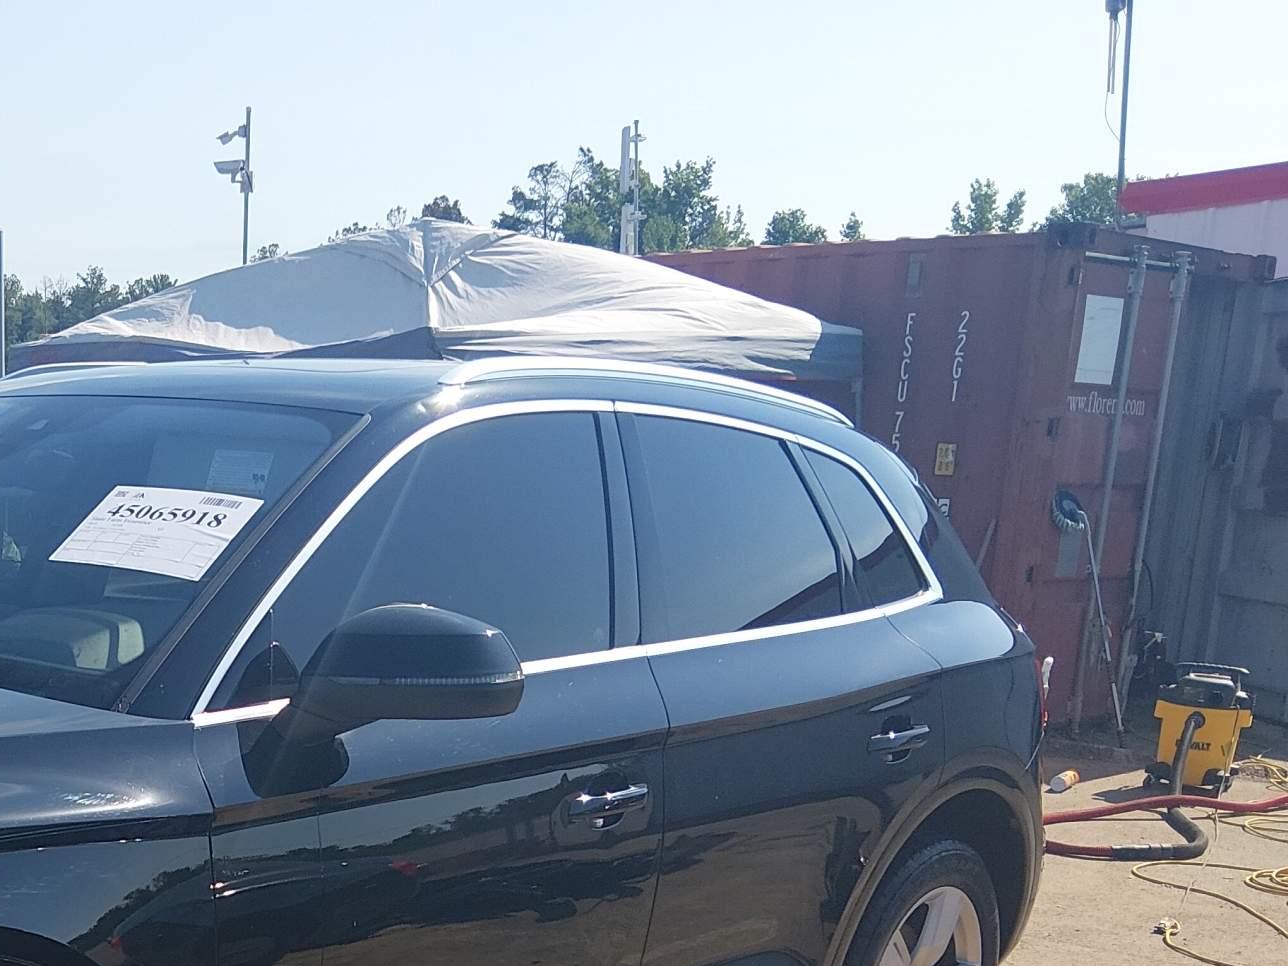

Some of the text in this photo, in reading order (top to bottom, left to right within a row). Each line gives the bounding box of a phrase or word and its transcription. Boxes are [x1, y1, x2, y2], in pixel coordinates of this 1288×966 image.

[897, 312, 917, 402] FSCU
[951, 310, 970, 402] 22G1
[106, 502, 228, 529] 45065918
